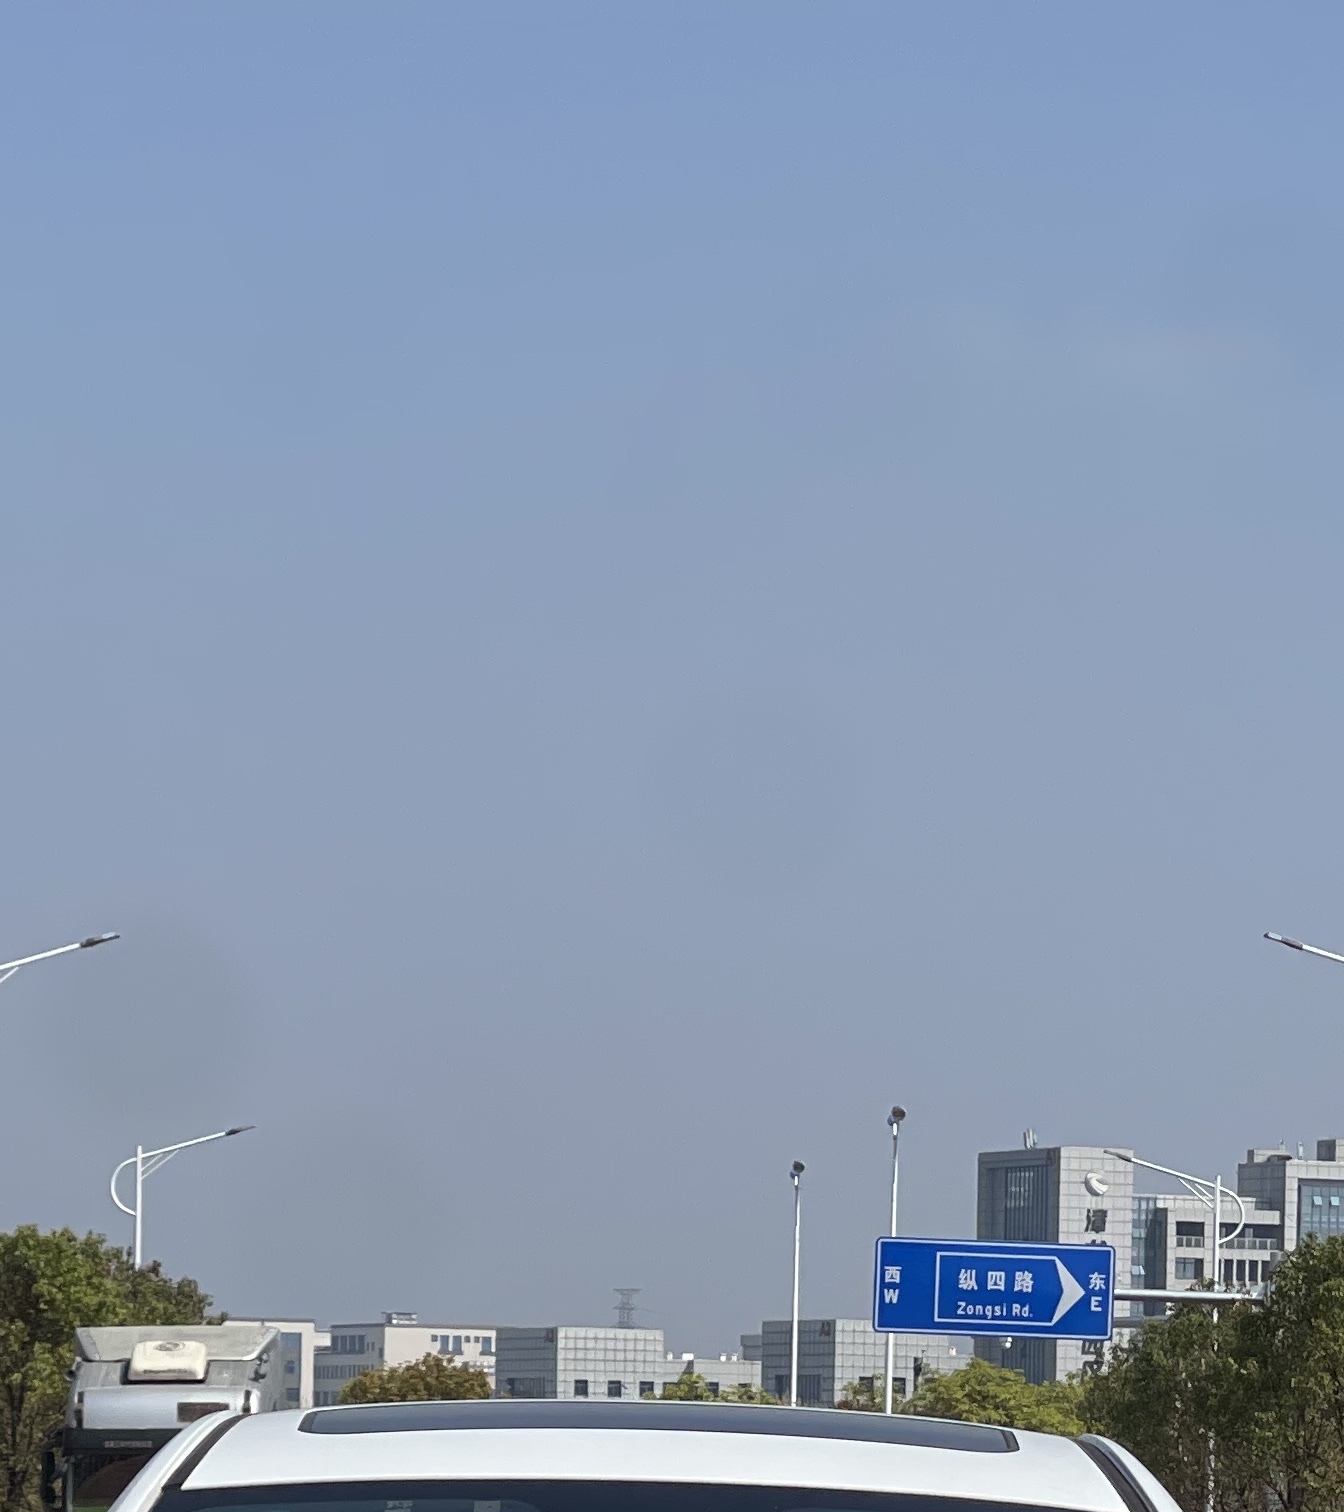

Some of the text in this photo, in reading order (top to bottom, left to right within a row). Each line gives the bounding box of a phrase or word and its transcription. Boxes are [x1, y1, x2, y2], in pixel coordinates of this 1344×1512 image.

[884, 1266, 902, 1284] 西
[958, 1268, 1034, 1293] 纵四路
[1088, 1271, 1106, 1291] 东
[884, 1289, 899, 1304] W
[1090, 1296, 1102, 1312] E
[957, 1301, 1033, 1319] Zongsi Rd.
